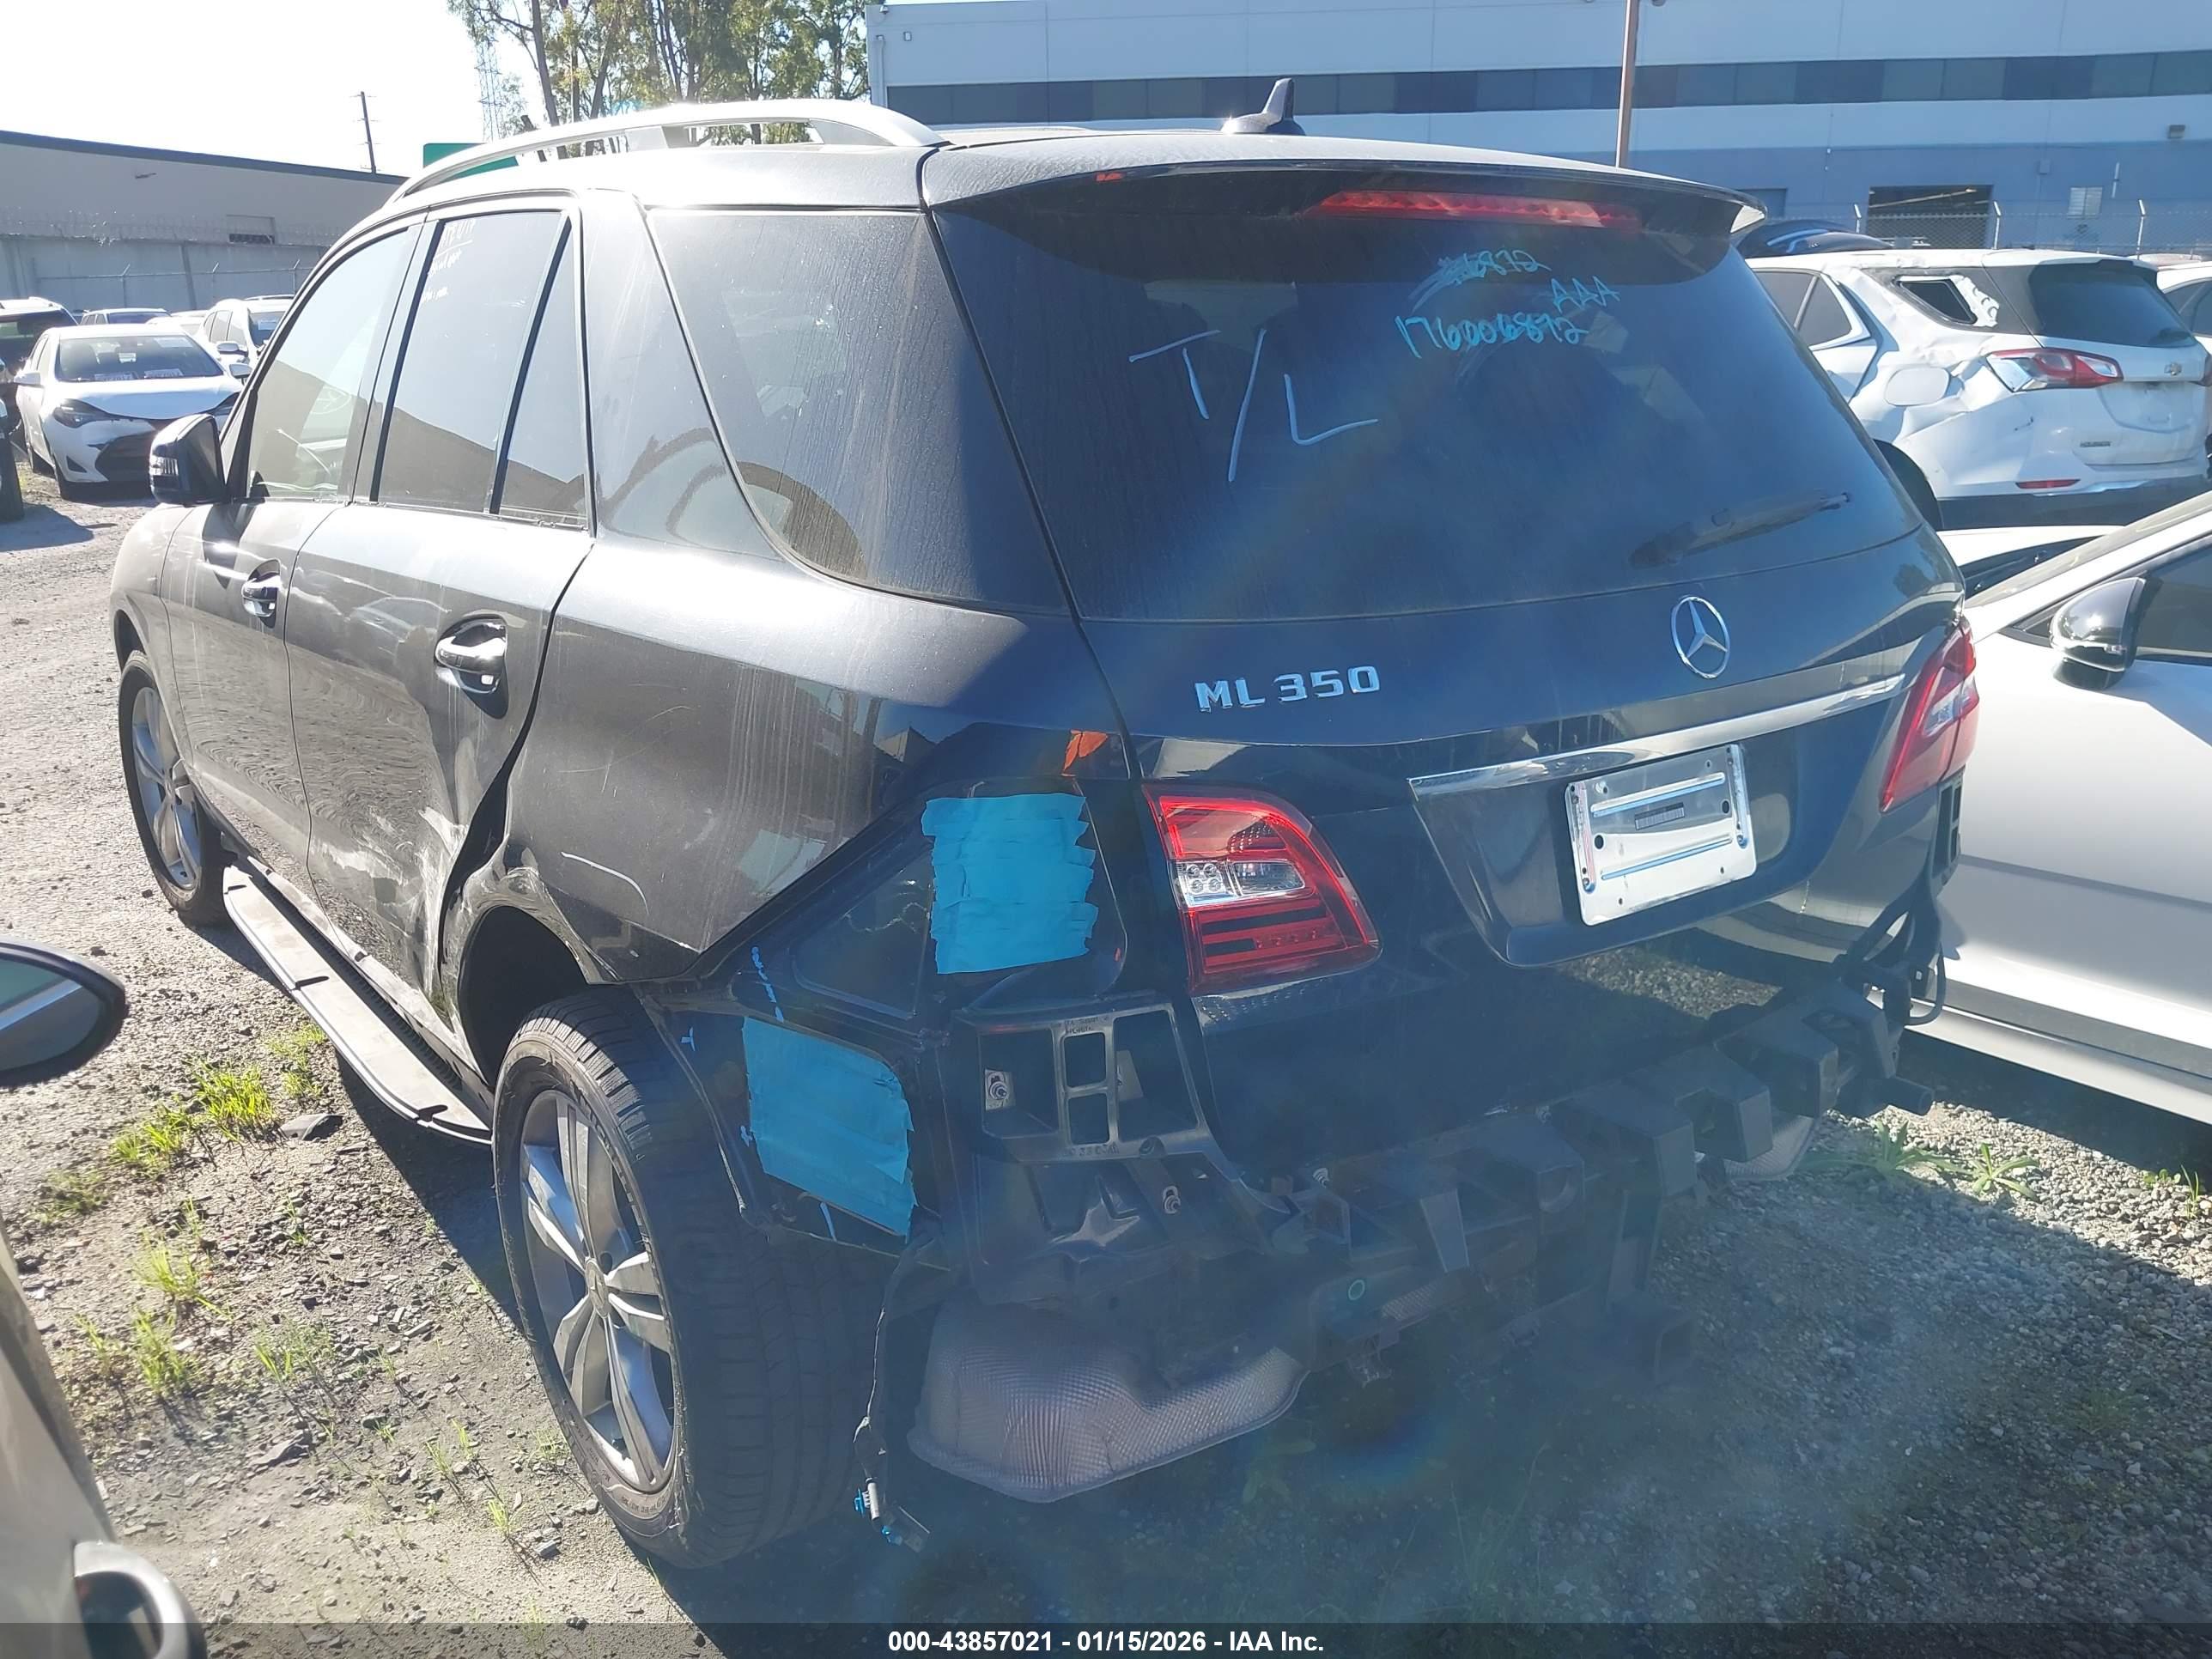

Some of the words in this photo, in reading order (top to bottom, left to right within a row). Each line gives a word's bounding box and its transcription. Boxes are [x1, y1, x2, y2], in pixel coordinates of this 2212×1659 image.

[1550, 276, 1621, 313] AAA
[1194, 677, 1266, 714] ML
[1273, 665, 1382, 703] 350
